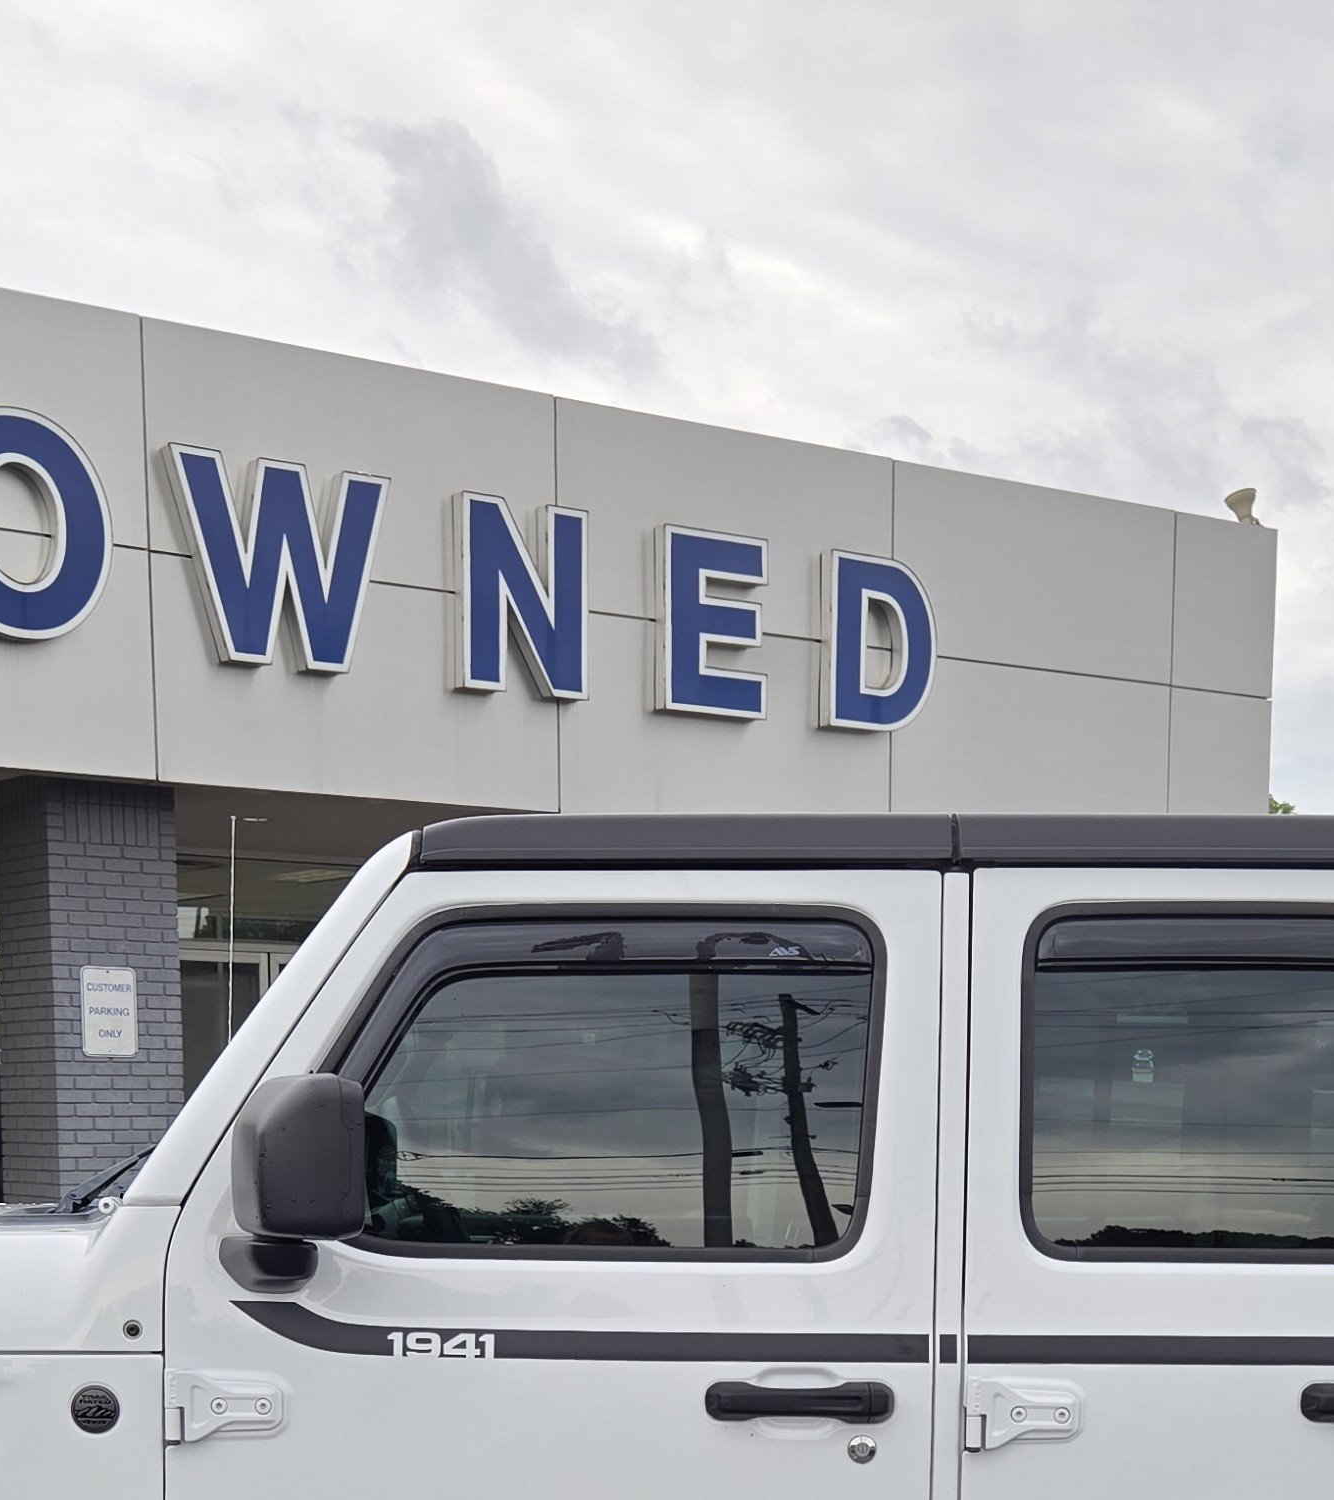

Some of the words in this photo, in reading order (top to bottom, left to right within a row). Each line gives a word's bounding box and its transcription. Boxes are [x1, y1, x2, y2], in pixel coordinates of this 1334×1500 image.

[86, 982, 132, 993] CUSTOMER
[88, 1006, 130, 1017] PARKING
[98, 1028, 123, 1038] ONLY
[387, 1331, 495, 1359] 1941
